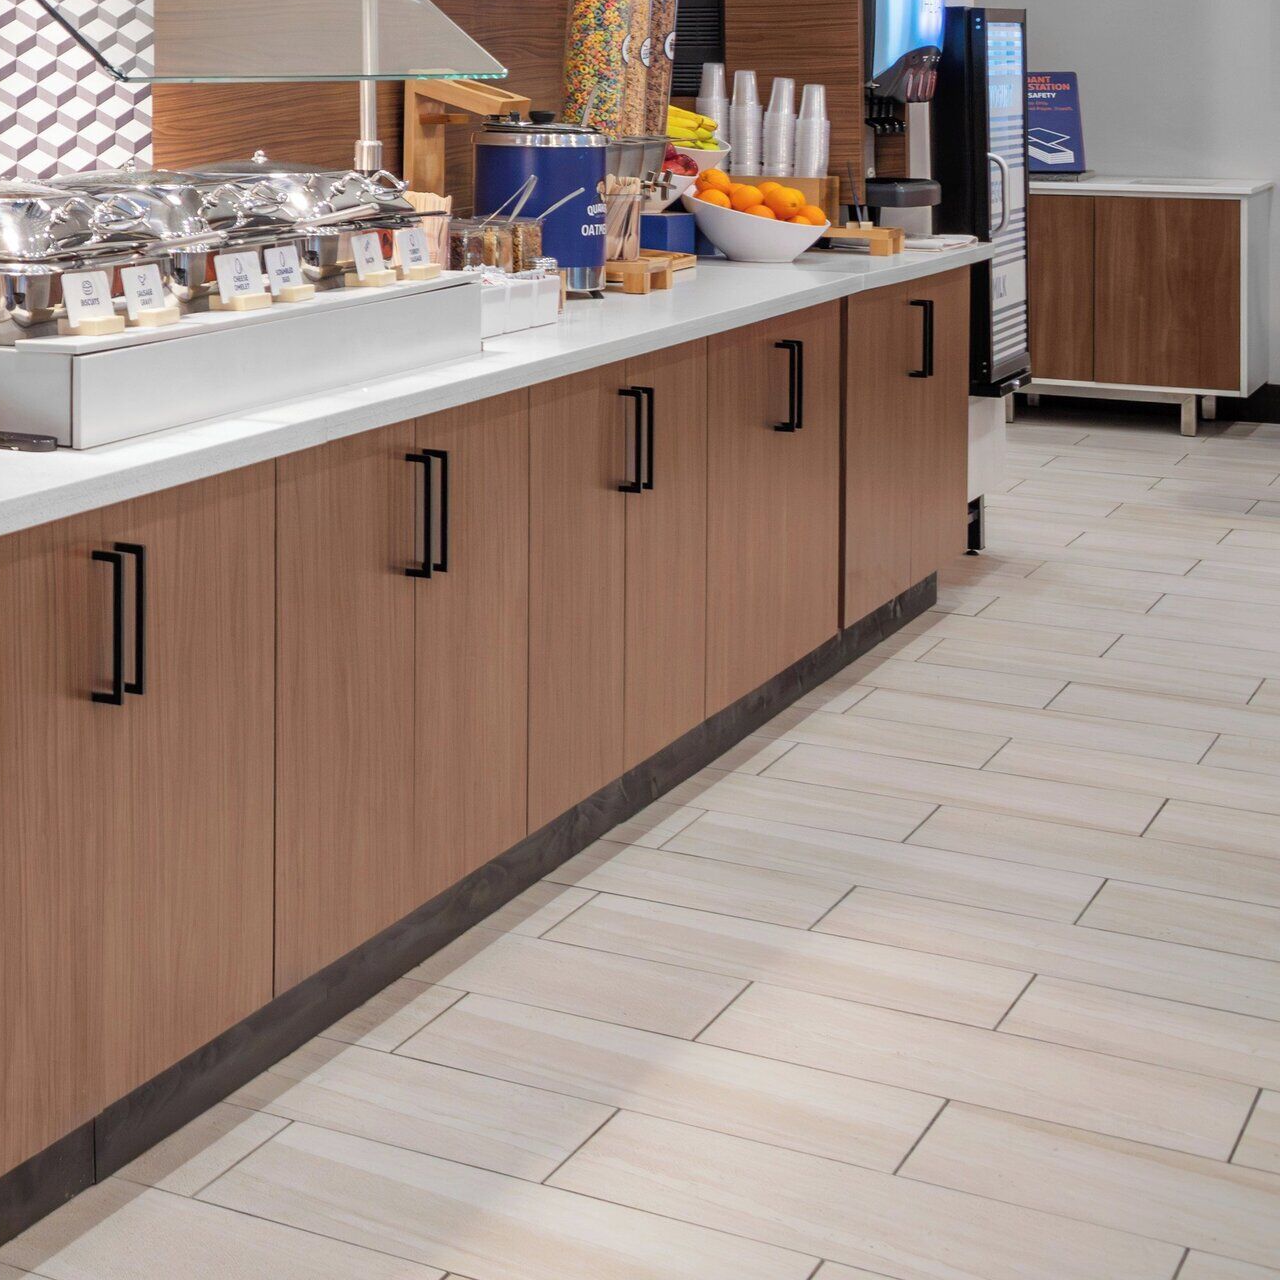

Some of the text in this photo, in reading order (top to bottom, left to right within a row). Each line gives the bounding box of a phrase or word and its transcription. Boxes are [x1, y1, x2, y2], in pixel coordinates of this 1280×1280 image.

[1028, 83, 1070, 91] STATION
[581, 224, 607, 236] OATME
[81, 297, 100, 307] BISCUITS
